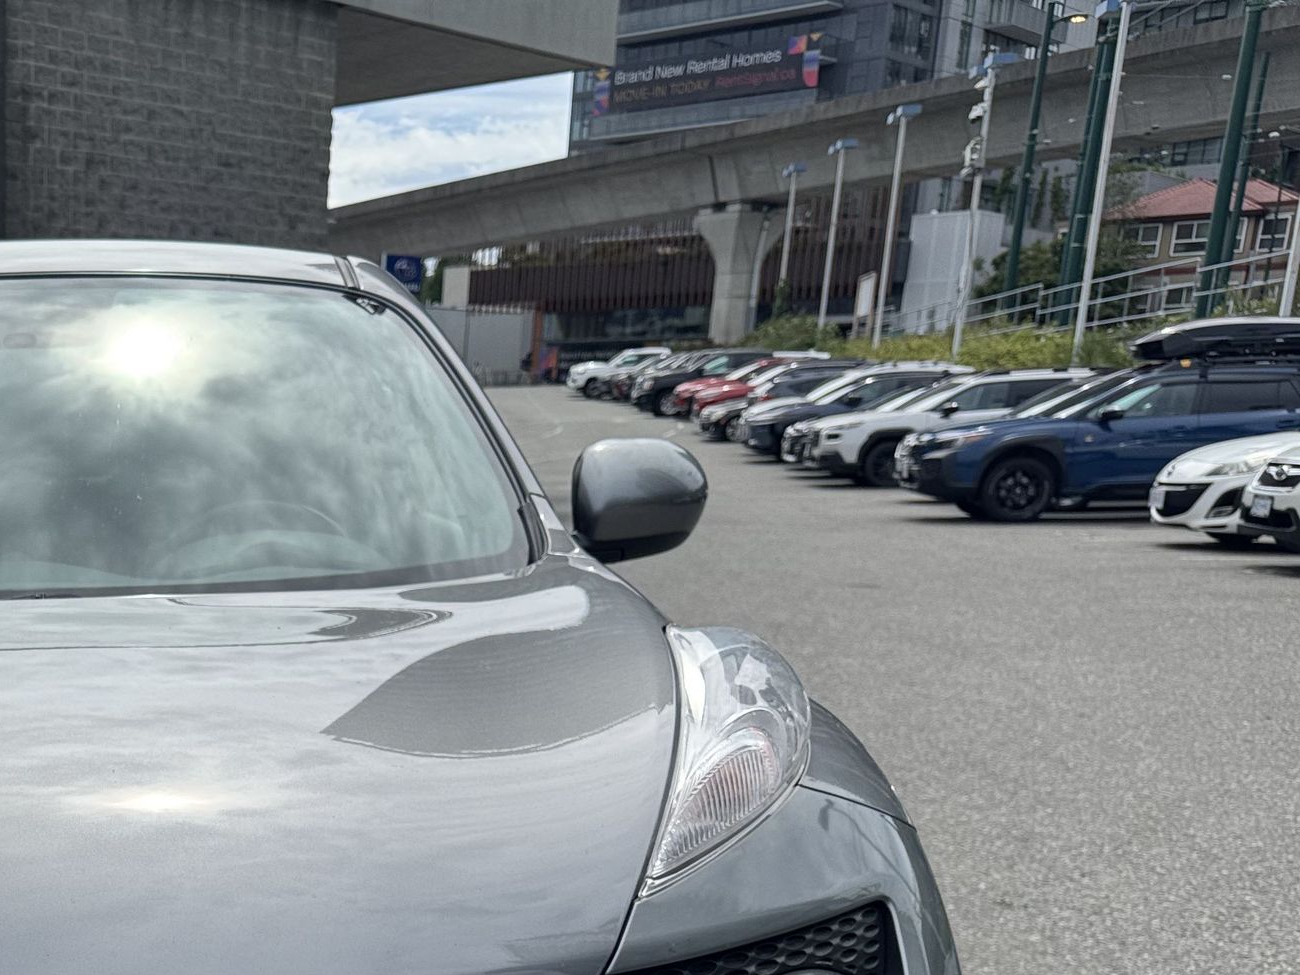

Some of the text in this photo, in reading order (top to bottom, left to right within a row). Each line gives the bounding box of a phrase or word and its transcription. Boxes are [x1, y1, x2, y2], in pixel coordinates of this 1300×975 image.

[614, 50, 782, 86] Brand New Rental Homes
